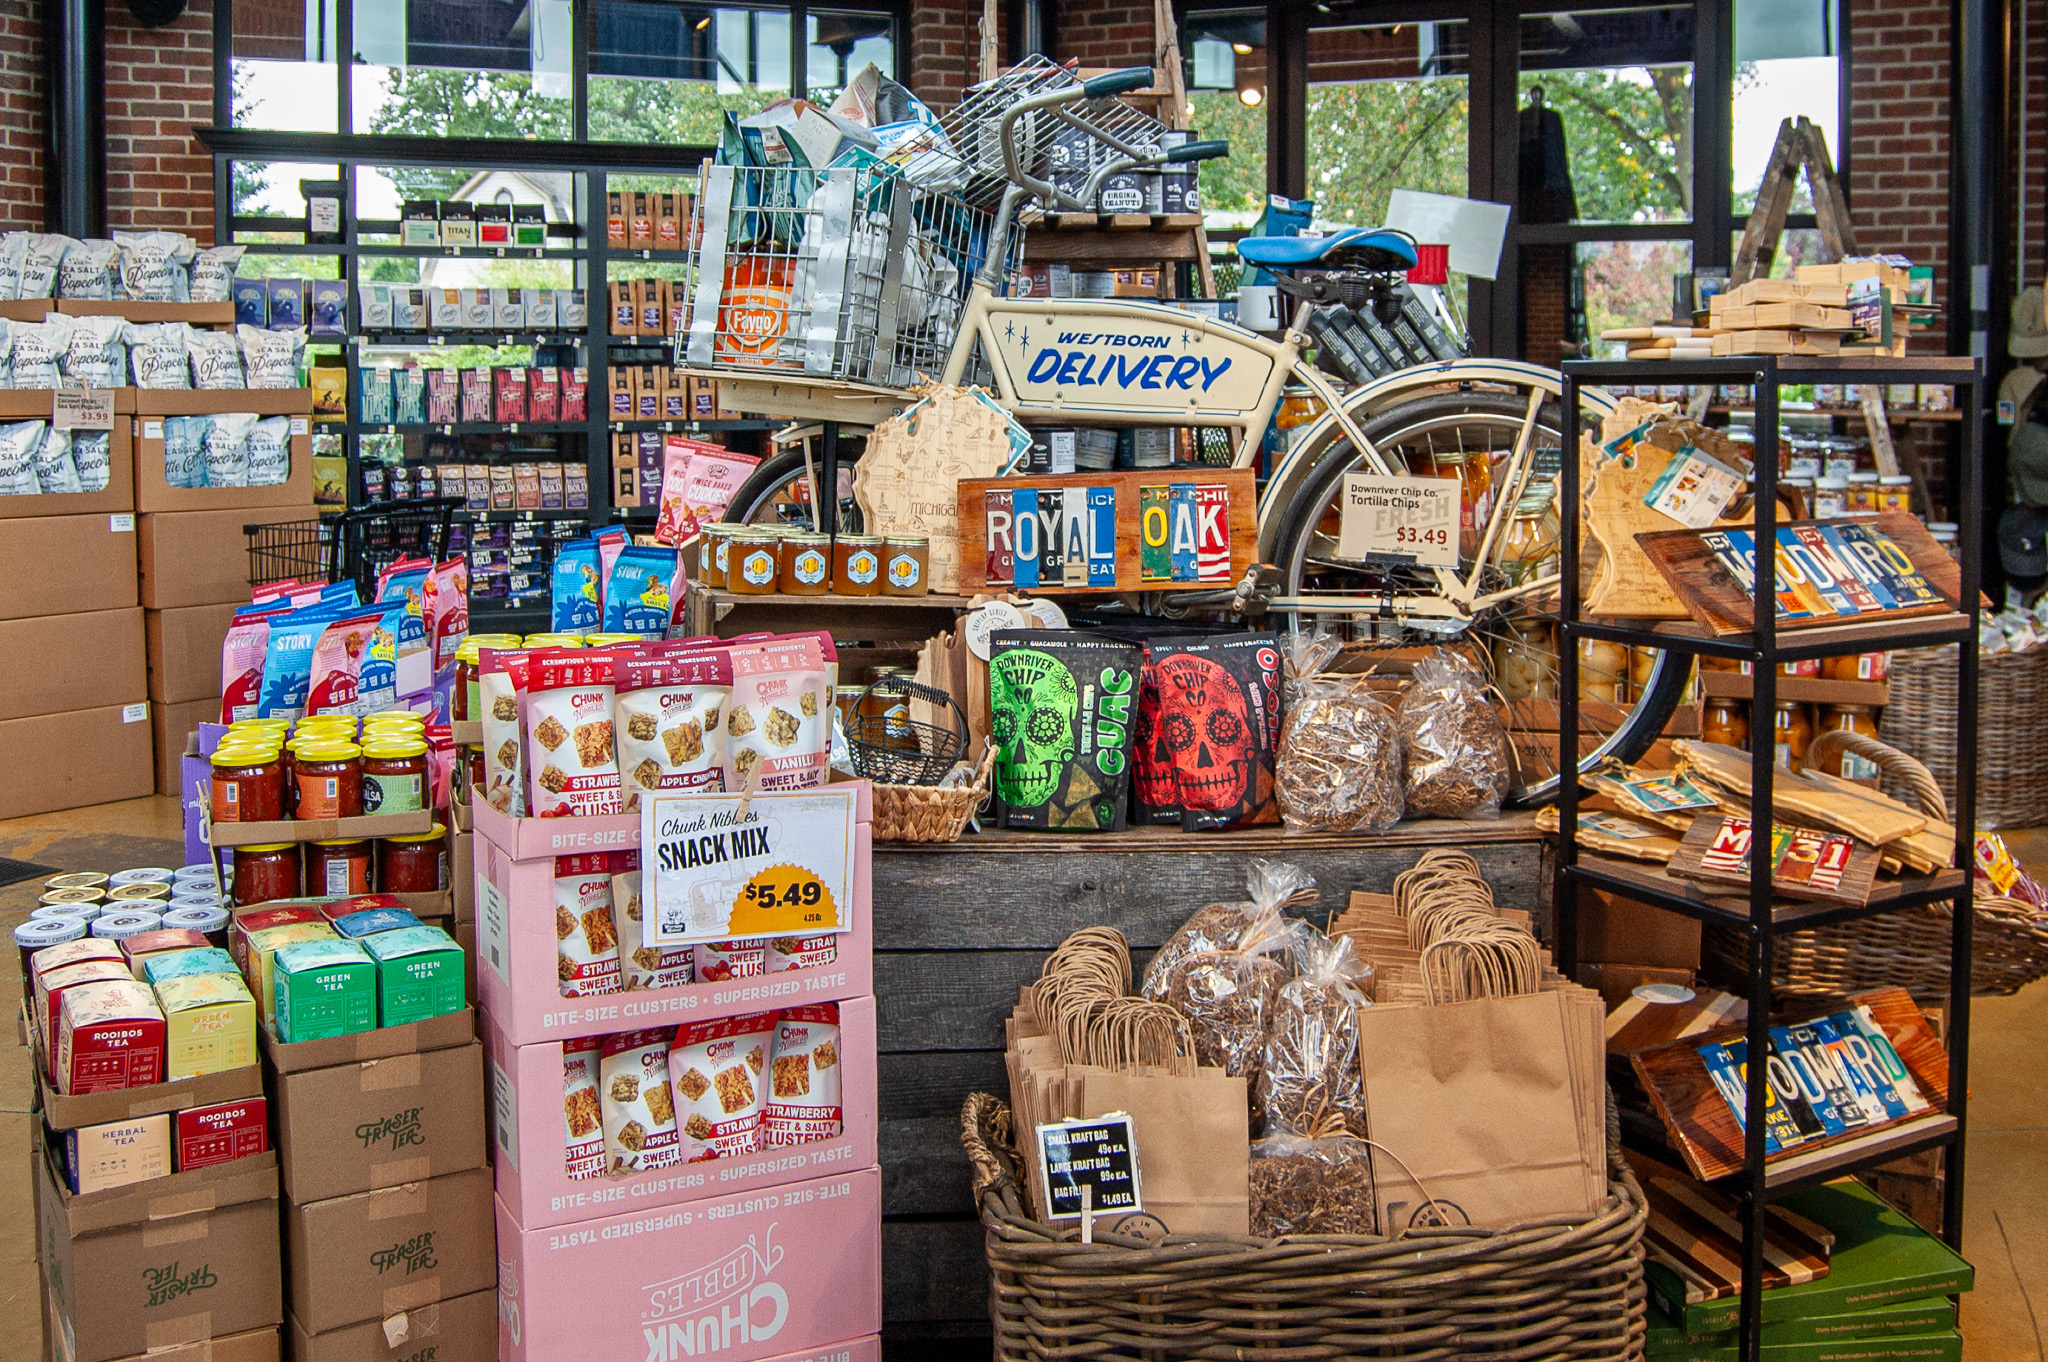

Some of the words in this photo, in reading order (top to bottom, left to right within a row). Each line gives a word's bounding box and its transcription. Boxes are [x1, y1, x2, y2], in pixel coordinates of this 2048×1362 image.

[447, 226, 471, 235] TITAN
[733, 310, 773, 334] Faygo
[1057, 332, 1171, 348] WESTBORN
[201, 355, 239, 382] Popco
[1027, 348, 1232, 393] DELIVERY
[81, 412, 108, 420] $3.99
[444, 486, 464, 495] BOLD
[469, 485, 488, 494] BOLD
[493, 485, 512, 494] BOLD
[519, 484, 538, 493] BOLD
[542, 484, 560, 494] BOLD
[692, 477, 712, 488] TWICE
[712, 481, 732, 491] BAKED
[1351, 484, 1399, 495] Downriver
[1401, 487, 1421, 498] Chip
[1424, 489, 1438, 498] Co.
[687, 486, 729, 504] COOKIES
[1351, 495, 1389, 507] Tortilla
[1391, 497, 1420, 510] Chips
[1375, 496, 1450, 533] FRESH
[987, 507, 1114, 564] ROYAL
[1143, 503, 1226, 556] OAK
[1396, 525, 1447, 545] $3.49
[616, 565, 644, 579] STORY
[231, 633, 262, 649] STORY
[277, 634, 312, 650] STORY
[1244, 639, 1275, 647] SNACKING
[731, 648, 761, 656] MPTIOUS
[591, 656, 613, 664] INGREDI
[996, 653, 1054, 672] DOWNRIVER
[1163, 658, 1212, 674] DOWNRIVER
[1004, 669, 1045, 686] CHIP
[1172, 672, 1209, 690] CHIP
[756, 679, 788, 695] CHUNK
[571, 693, 604, 708] CHUNK
[660, 693, 693, 708] CHUNK
[1014, 688, 1033, 704] CO
[1083, 684, 1094, 709] CHIPS
[1185, 690, 1206, 707] CO
[1096, 667, 1133, 776] GUAC
[1081, 711, 1094, 754] TORTILLA
[771, 753, 814, 771] VANILL
[572, 776, 620, 789] STRAWBE
[660, 775, 690, 787] APPLE
[761, 776, 795, 787] SWEET
[570, 792, 604, 803] SWEET
[571, 801, 623, 817] CLUSTE
[661, 815, 707, 837] Chunk
[552, 829, 627, 849] BITE-SIZE
[657, 833, 729, 873] SNACK
[731, 826, 771, 860] MIX
[579, 881, 611, 896] CHUNK
[745, 881, 822, 909] $5.49
[804, 914, 815, 922] 4.25
[660, 955, 685, 967] APPLE
[728, 952, 761, 964] SWEET
[800, 950, 832, 964] SWEET
[407, 961, 441, 972] GREEN
[729, 963, 764, 978] CLUS
[316, 973, 351, 984] GREEN
[414, 970, 434, 979] TEA
[658, 970, 687, 983] SWEET
[323, 982, 344, 991] TEA
[580, 979, 611, 991] SWEET
[543, 1005, 618, 1028] BITE-SIZE
[622, 994, 698, 1017] CLUSTERS
[713, 980, 801, 1006] SUPERSIZED
[805, 972, 847, 991] TASTE
[194, 1012, 230, 1024] GREEN
[201, 1022, 222, 1031] TEA
[780, 1026, 809, 1041] CHUNK
[93, 1029, 143, 1041] ROOIBOS
[107, 1038, 129, 1048] TEA
[707, 1040, 735, 1057] CHUNK
[641, 1050, 668, 1066] CHUN
[199, 1108, 246, 1123] ROOIBOS
[766, 1105, 835, 1119] STRAWBERRY
[212, 1119, 234, 1129] TEA
[355, 1106, 422, 1149] FRASER
[805, 1120, 835, 1132] SALTY
[102, 1126, 147, 1139] HERBAL
[1048, 1134, 1071, 1146] SMALL
[1071, 1131, 1094, 1143] KRAFT
[1094, 1130, 1109, 1140] BAG
[114, 1136, 136, 1146] TEA
[645, 1134, 671, 1147] APPLE
[715, 1136, 749, 1150] SWEET
[1113, 1144, 1127, 1152] EA.
[566, 1143, 604, 1159] STRAWB
[643, 1150, 676, 1164] SWEET
[1050, 1162, 1073, 1174] LARGE
[1073, 1159, 1095, 1171] KRAFT
[1095, 1158, 1111, 1168] BAG
[551, 1188, 626, 1211] BITE-SIZE
[630, 1174, 705, 1196] CLUSTERS
[720, 1156, 807, 1182] SUPERSIZED
[810, 1145, 853, 1164] TASTE
[1116, 1171, 1129, 1180] EA.
[784, 1181, 850, 1205] BITE-SIZE
[1054, 1186, 1068, 1198] BAG
[1069, 1186, 1082, 1196] FILL
[1103, 1194, 1121, 1205] $1.49
[1122, 1192, 1133, 1203] EA.
[708, 1194, 779, 1221] CLUSTERS
[602, 1210, 693, 1239] SUPERSIZED
[550, 1230, 598, 1250] TASTE
[370, 1231, 435, 1275] FRASER
[650, 1221, 785, 1318] NIBBLES
[144, 1263, 218, 1308] FRASER
[643, 1281, 790, 1362] CHUNK
